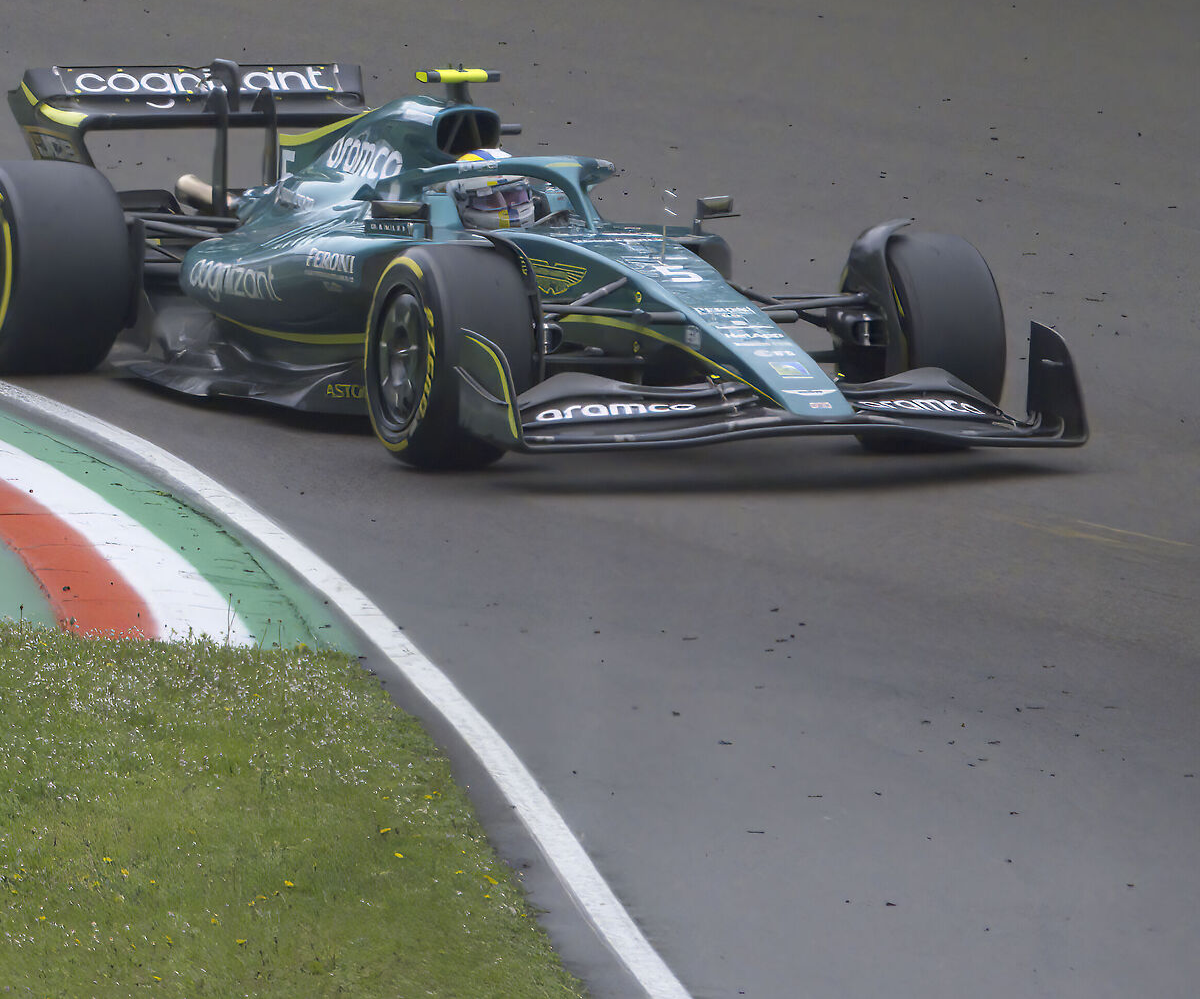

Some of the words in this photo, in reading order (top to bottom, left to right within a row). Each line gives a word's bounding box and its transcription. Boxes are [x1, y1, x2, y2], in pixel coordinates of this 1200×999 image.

[74, 66, 334, 109] cognant
[326, 384, 368, 399] ASTO
[535, 403, 697, 422] aramco
